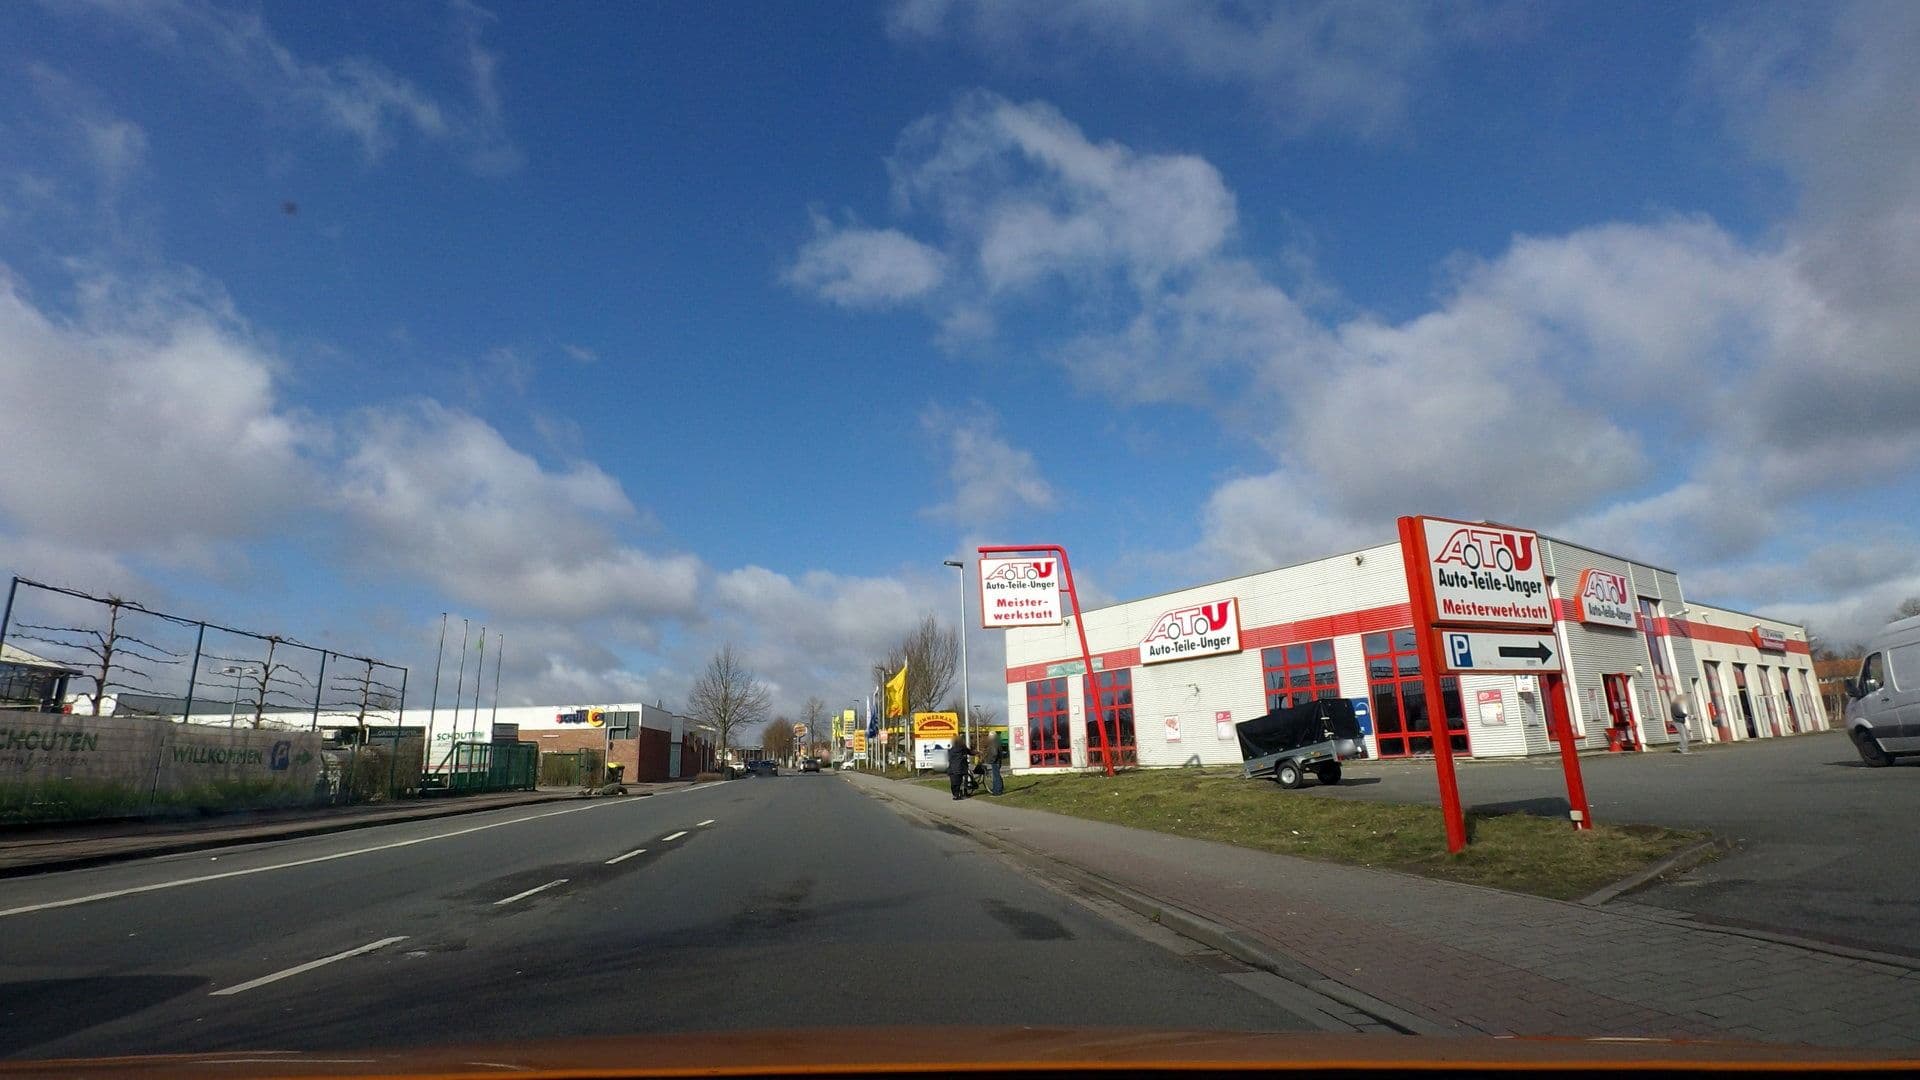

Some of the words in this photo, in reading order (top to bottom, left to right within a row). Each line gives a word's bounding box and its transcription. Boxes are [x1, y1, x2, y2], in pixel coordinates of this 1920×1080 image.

[986, 580, 1055, 590] Auto-Teile-Unger
[1438, 568, 1542, 598] Auto-Teile-Unger
[996, 597, 1049, 608] Meister-
[1442, 598, 1548, 619] Meisterwerkstatt
[993, 610, 1053, 620] werkstatt
[1149, 636, 1231, 657] Auto-Teile-Unger
[1452, 635, 1468, 666] P
[173, 745, 264, 765] WILLKOMMEN
